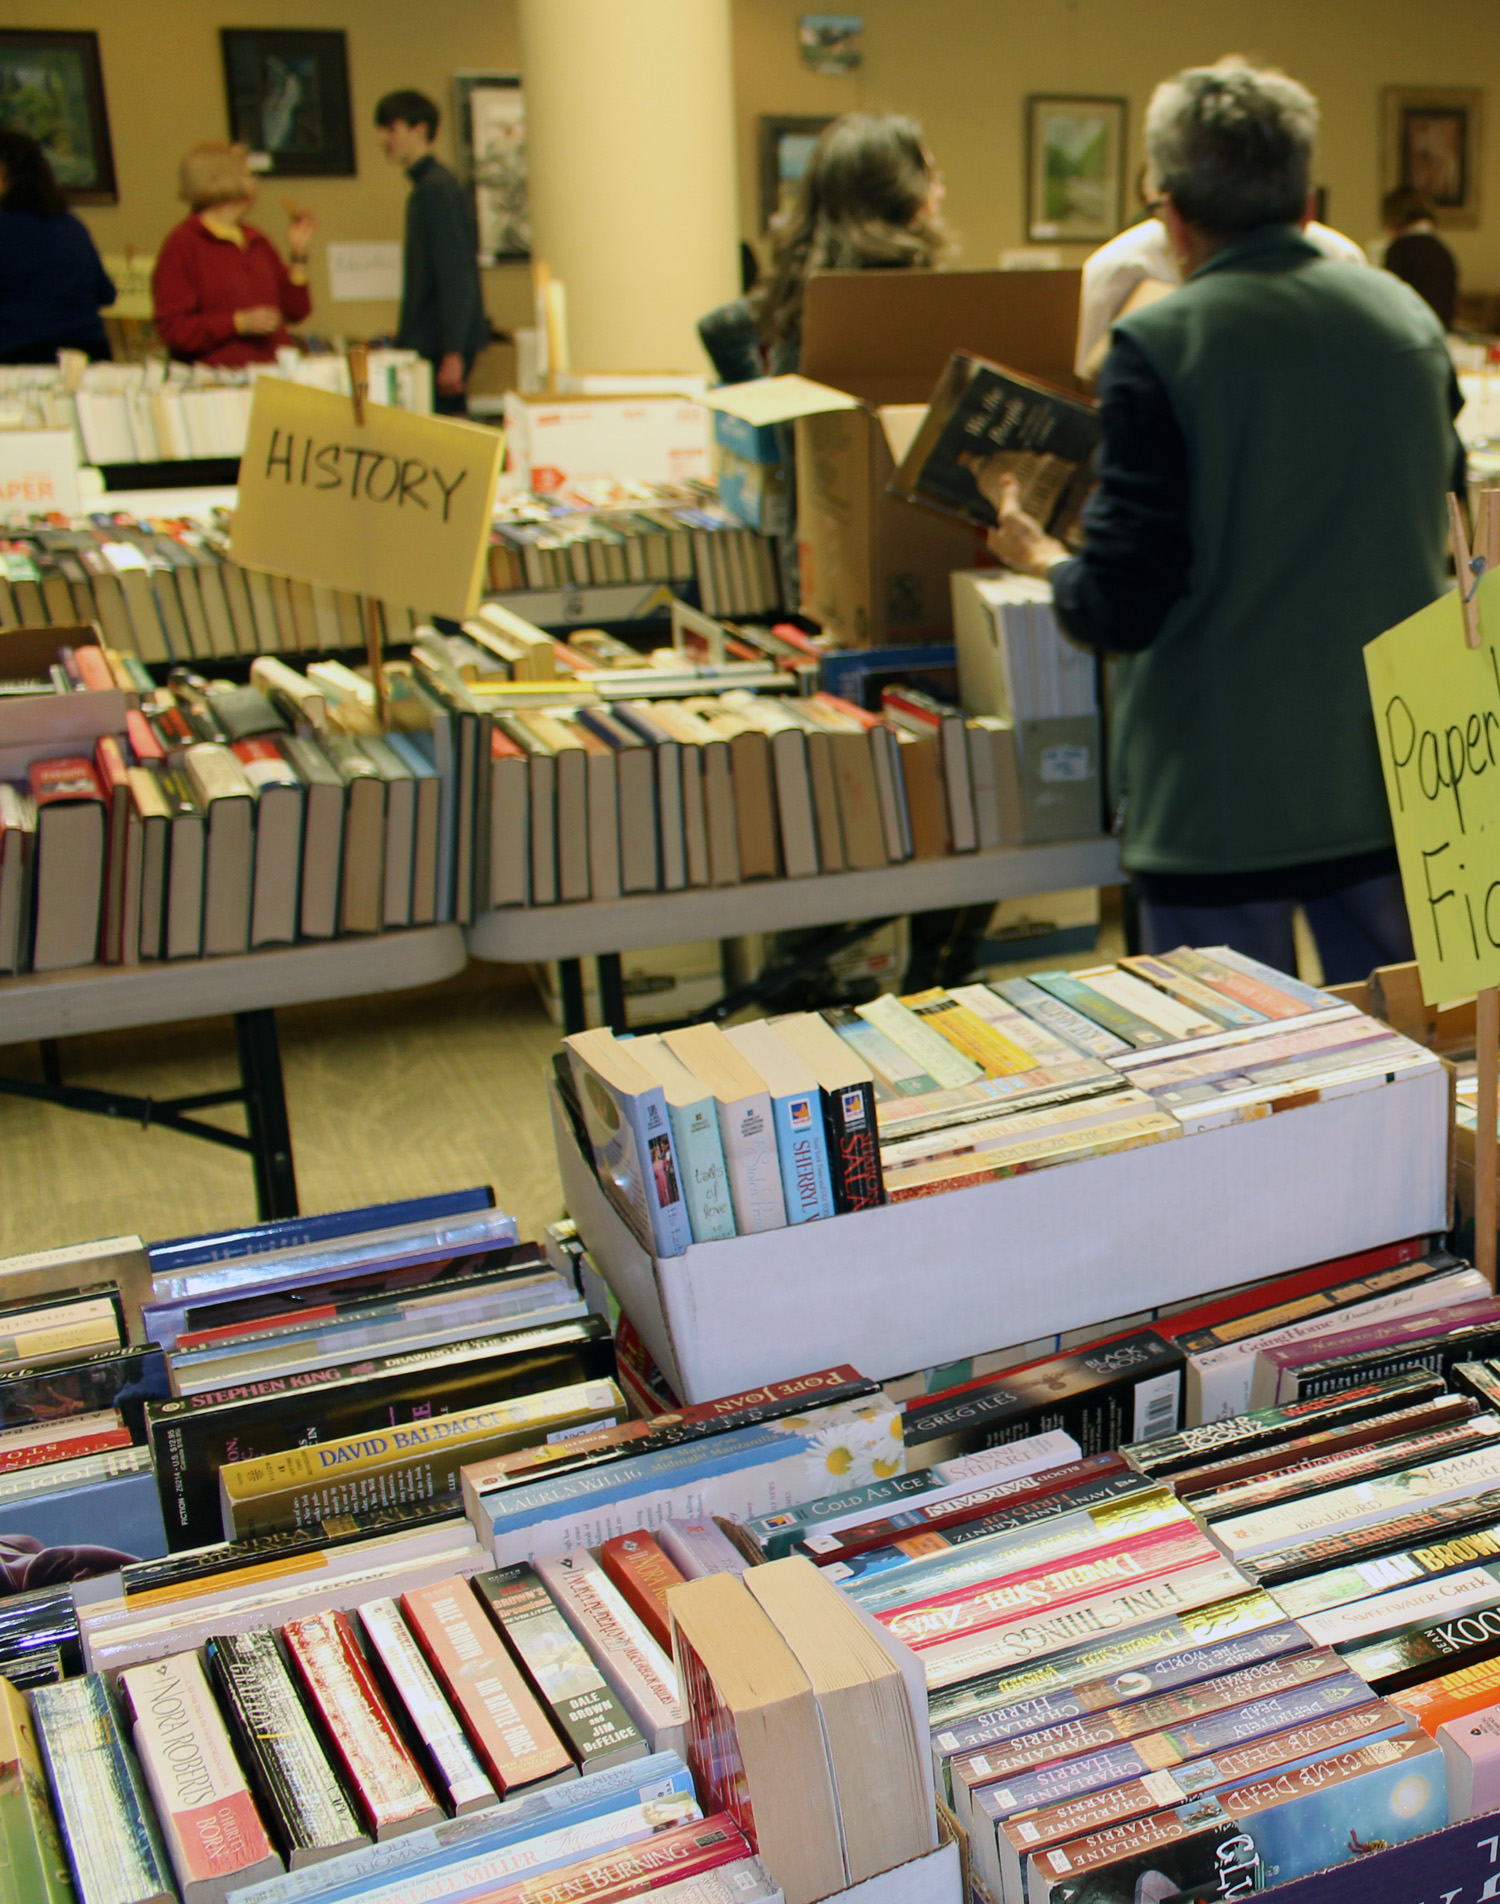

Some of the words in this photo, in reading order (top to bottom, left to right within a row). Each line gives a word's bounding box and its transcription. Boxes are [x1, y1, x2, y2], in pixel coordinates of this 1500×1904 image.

[266, 429, 468, 523] HISTORY
[793, 1140, 819, 1214] SHERRYL
[840, 1136, 870, 1212] SALA
[863, 1132, 881, 1205] SHARON
[705, 1182, 718, 1201] of
[703, 1202, 728, 1220] love
[384, 1350, 450, 1368] DRAWING
[451, 1341, 471, 1354] OF
[473, 1335, 500, 1351] THE
[1084, 1344, 1138, 1371] BLACK
[1095, 1350, 1149, 1378] CROSS
[191, 1381, 286, 1407] STEPHEN
[289, 1368, 341, 1387] KING
[713, 1385, 781, 1413] JOAN
[778, 1371, 847, 1395] POPE
[916, 1404, 978, 1434] GREG
[978, 1391, 1019, 1415] ILES
[1280, 1385, 1383, 1417] WATCHERS
[167, 1430, 177, 1452] $12.95
[319, 1438, 388, 1469] DAVID
[392, 1412, 501, 1450] BALDACCI
[676, 1442, 709, 1457] Mark
[1186, 1419, 1270, 1451] KOONTZ
[651, 1453, 709, 1475] Midnight
[709, 1433, 780, 1458] Manzanilla
[949, 1451, 1032, 1481] STUART
[963, 1445, 1016, 1467] ANNE
[1037, 1464, 1081, 1483] BLOOD
[497, 1484, 579, 1515] LAUREN
[585, 1467, 642, 1495] WILLIG
[811, 1492, 863, 1516] COLD
[892, 1475, 925, 1494] ICE
[926, 1476, 1041, 1518] BARGAIN
[1015, 1493, 1074, 1515] FIRED
[1066, 1480, 1116, 1506] JAYNE
[180, 1498, 189, 1527] FICTION
[982, 1511, 1012, 1528] UP
[1022, 1503, 1066, 1522] ANN
[1296, 1500, 1382, 1530] BRADFORD
[952, 1517, 1022, 1544] KRENTZ
[1302, 1533, 1352, 1559] LISA
[1350, 1513, 1442, 1545] GARDNER
[1044, 1552, 1146, 1591] DANIELLE
[1354, 1552, 1425, 1589] DAN
[431, 1596, 463, 1626] DALE
[491, 1587, 546, 1611] BROWN'S
[974, 1580, 1050, 1612] STEEL
[1113, 1581, 1184, 1614] FINE
[1340, 1592, 1437, 1626] SWEETWATER
[1437, 1575, 1492, 1599] CREEK
[446, 1620, 485, 1662] BROWN
[1002, 1607, 1123, 1658] THINGS
[1423, 1629, 1453, 1655] DEAN
[1154, 1652, 1211, 1675] WORLD
[1197, 1658, 1218, 1672] TO
[1212, 1642, 1247, 1661] THE
[474, 1677, 503, 1698] AIR
[1203, 1660, 1284, 1693] DOORNAIL
[1236, 1681, 1259, 1697] AS
[1263, 1672, 1299, 1693] DEAD
[150, 1676, 183, 1738] NORA
[483, 1692, 520, 1730] BATTLE
[568, 1691, 601, 1711] DALE
[568, 1699, 614, 1723] BROWN
[977, 1695, 1052, 1727] HARRIS
[1239, 1699, 1284, 1721] DEAD
[592, 1722, 616, 1739] JIM
[964, 1704, 1080, 1746] CHARLAINE
[1010, 1719, 1087, 1751] HARRIS
[1232, 1700, 1325, 1740] DEFINITELY
[1287, 1716, 1351, 1747] CLUB
[503, 1721, 538, 1758] FORCE
[996, 1728, 1114, 1771] CHARLAINE
[162, 1733, 218, 1807] ROBERTS
[1036, 1754, 1114, 1786] HARRIS
[1216, 1740, 1287, 1777] DEAD
[1299, 1753, 1363, 1788] CLUB
[1023, 1761, 1142, 1804] CHARLAINE
[1226, 1775, 1300, 1812] DEAD
[1045, 1794, 1152, 1835] CHARLAINE
[1057, 1788, 1128, 1819] HARRIS
[196, 1816, 224, 1861] BORN
[1073, 1824, 1183, 1867] CHARLAINE
[1086, 1816, 1157, 1848] HARRIS
[348, 1841, 431, 1875] THOMAS
[408, 1874, 459, 1899] LAEL
[463, 1849, 539, 1885] MILLER
[585, 1843, 691, 1888] BURNING
